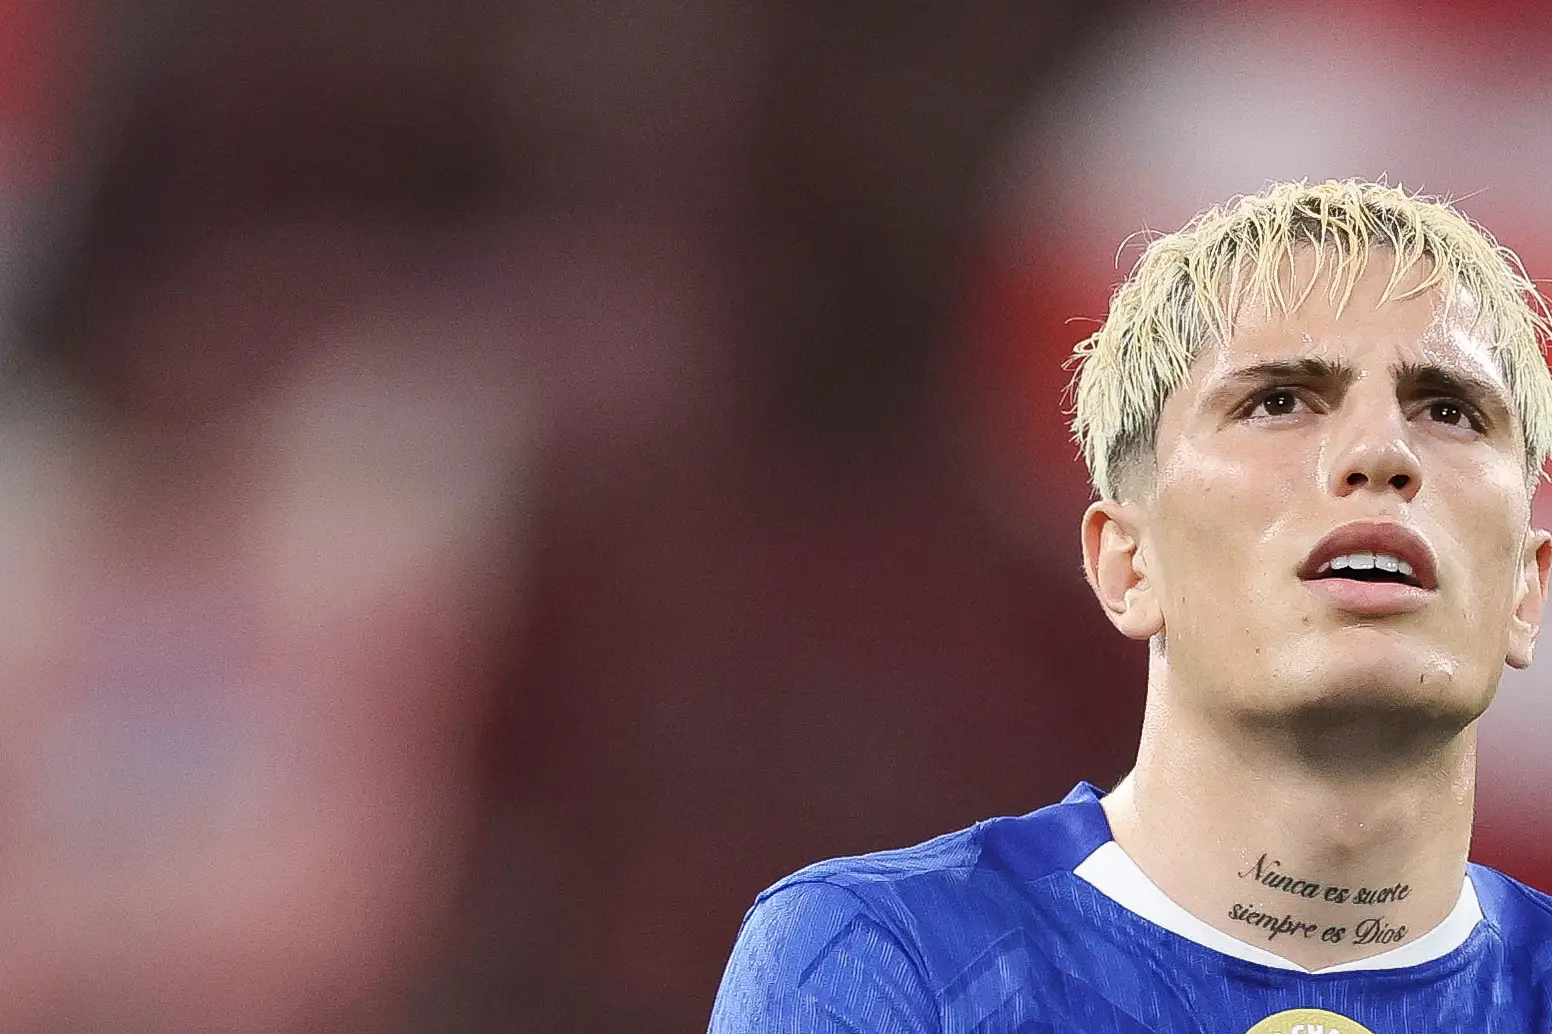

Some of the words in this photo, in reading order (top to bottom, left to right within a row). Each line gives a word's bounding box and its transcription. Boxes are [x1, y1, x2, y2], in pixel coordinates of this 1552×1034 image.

[1238, 853, 1320, 898] Nunca
[1324, 886, 1350, 904] es
[1228, 903, 1317, 940] siempre
[1320, 925, 1346, 943] es
[1353, 916, 1408, 945] Dios
